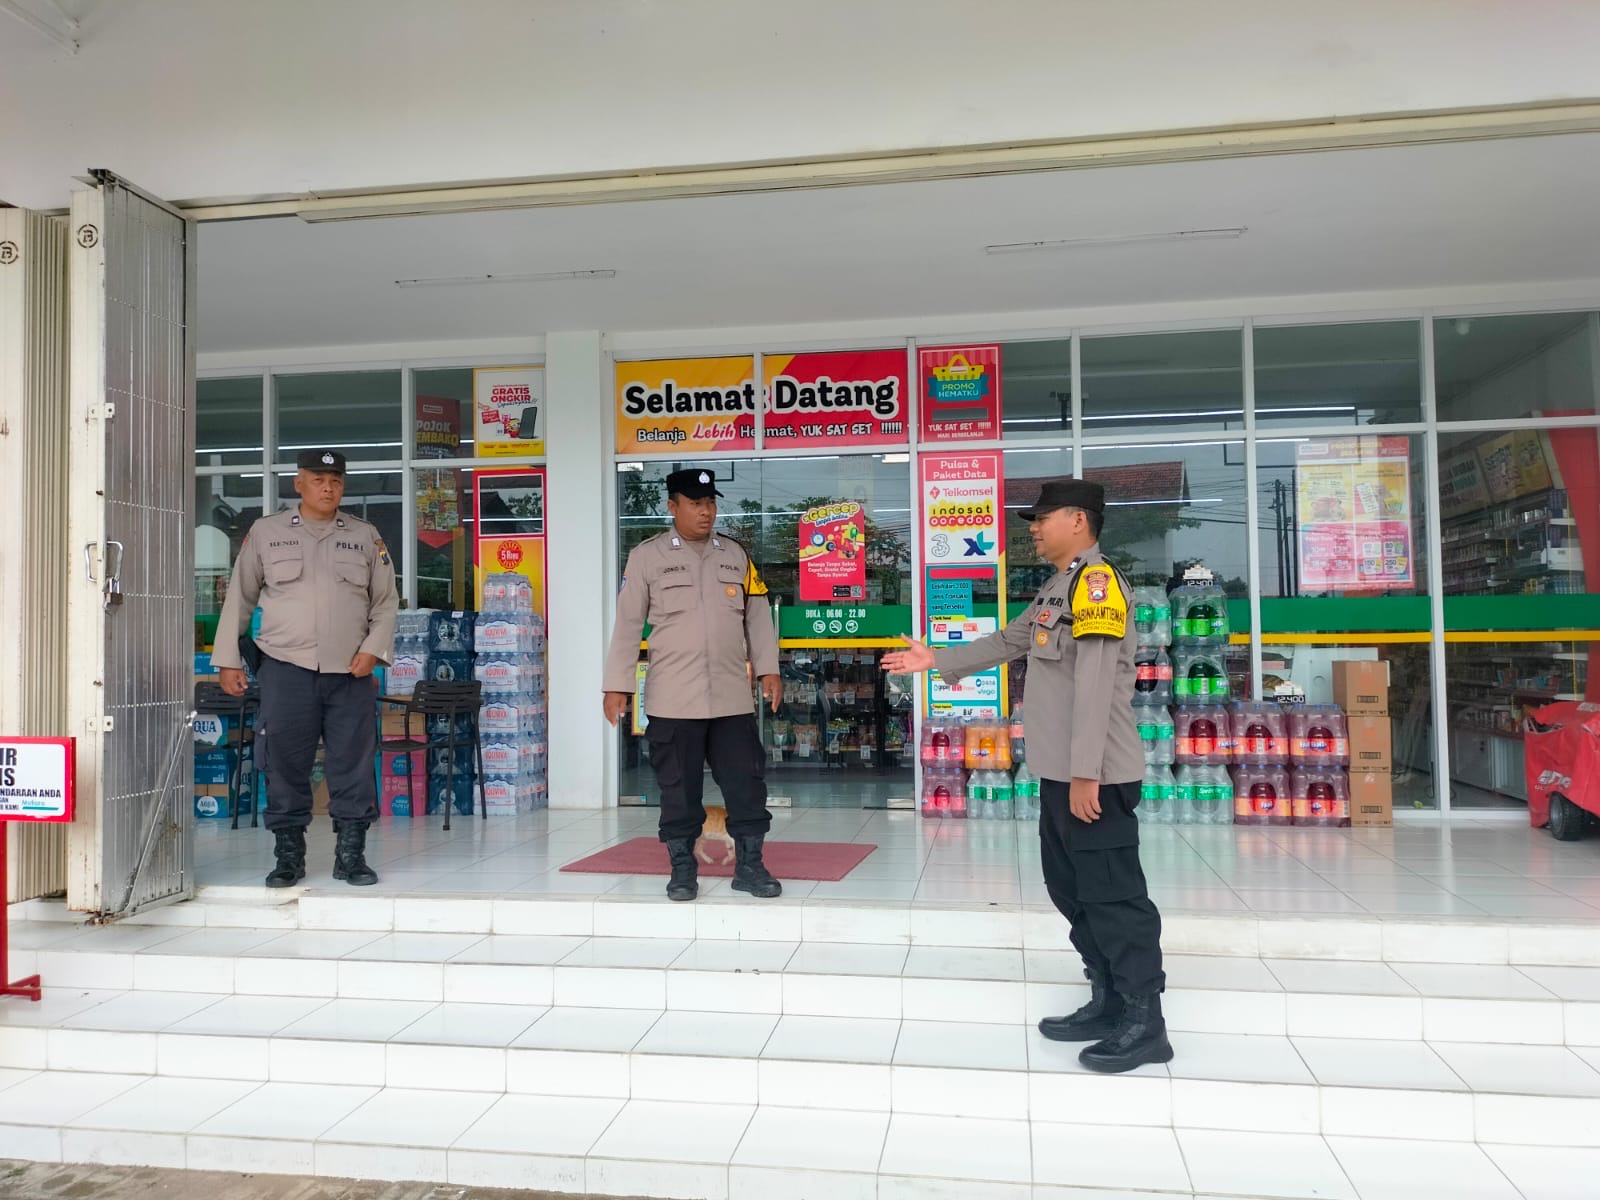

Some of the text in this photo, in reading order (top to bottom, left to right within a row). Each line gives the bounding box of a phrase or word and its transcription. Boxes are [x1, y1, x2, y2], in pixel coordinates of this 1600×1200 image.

[492, 387, 530, 395] GRATIS
[490, 395, 531, 403] ONGKIR
[625, 380, 895, 415] Selamat Datang
[927, 424, 943, 432] YUK
[944, 423, 958, 431] SAT
[960, 422, 973, 430] SET
[416, 431, 459, 447] EMBAKO
[637, 428, 686, 444] Belanja
[692, 423, 736, 440] Lebih
[740, 424, 798, 438] Hemat,
[800, 424, 823, 436] YUK
[827, 423, 848, 435] SAT
[852, 423, 872, 435] SET
[940, 459, 980, 469] Pulsa &
[933, 470, 987, 479] Paket Data
[942, 486, 993, 497] Telkomsel
[932, 504, 991, 515] indosat
[930, 515, 993, 526] ooredoo
[336, 541, 364, 552] POLRI
[963, 530, 995, 557] XL
[1047, 597, 1064, 608] POLRI
[805, 609, 821, 618] BUKA
[193, 720, 217, 734] QUA
[0, 748, 17, 766] IR
[39, 788, 61, 798] ANDA
[200, 801, 216, 809] AQUA
